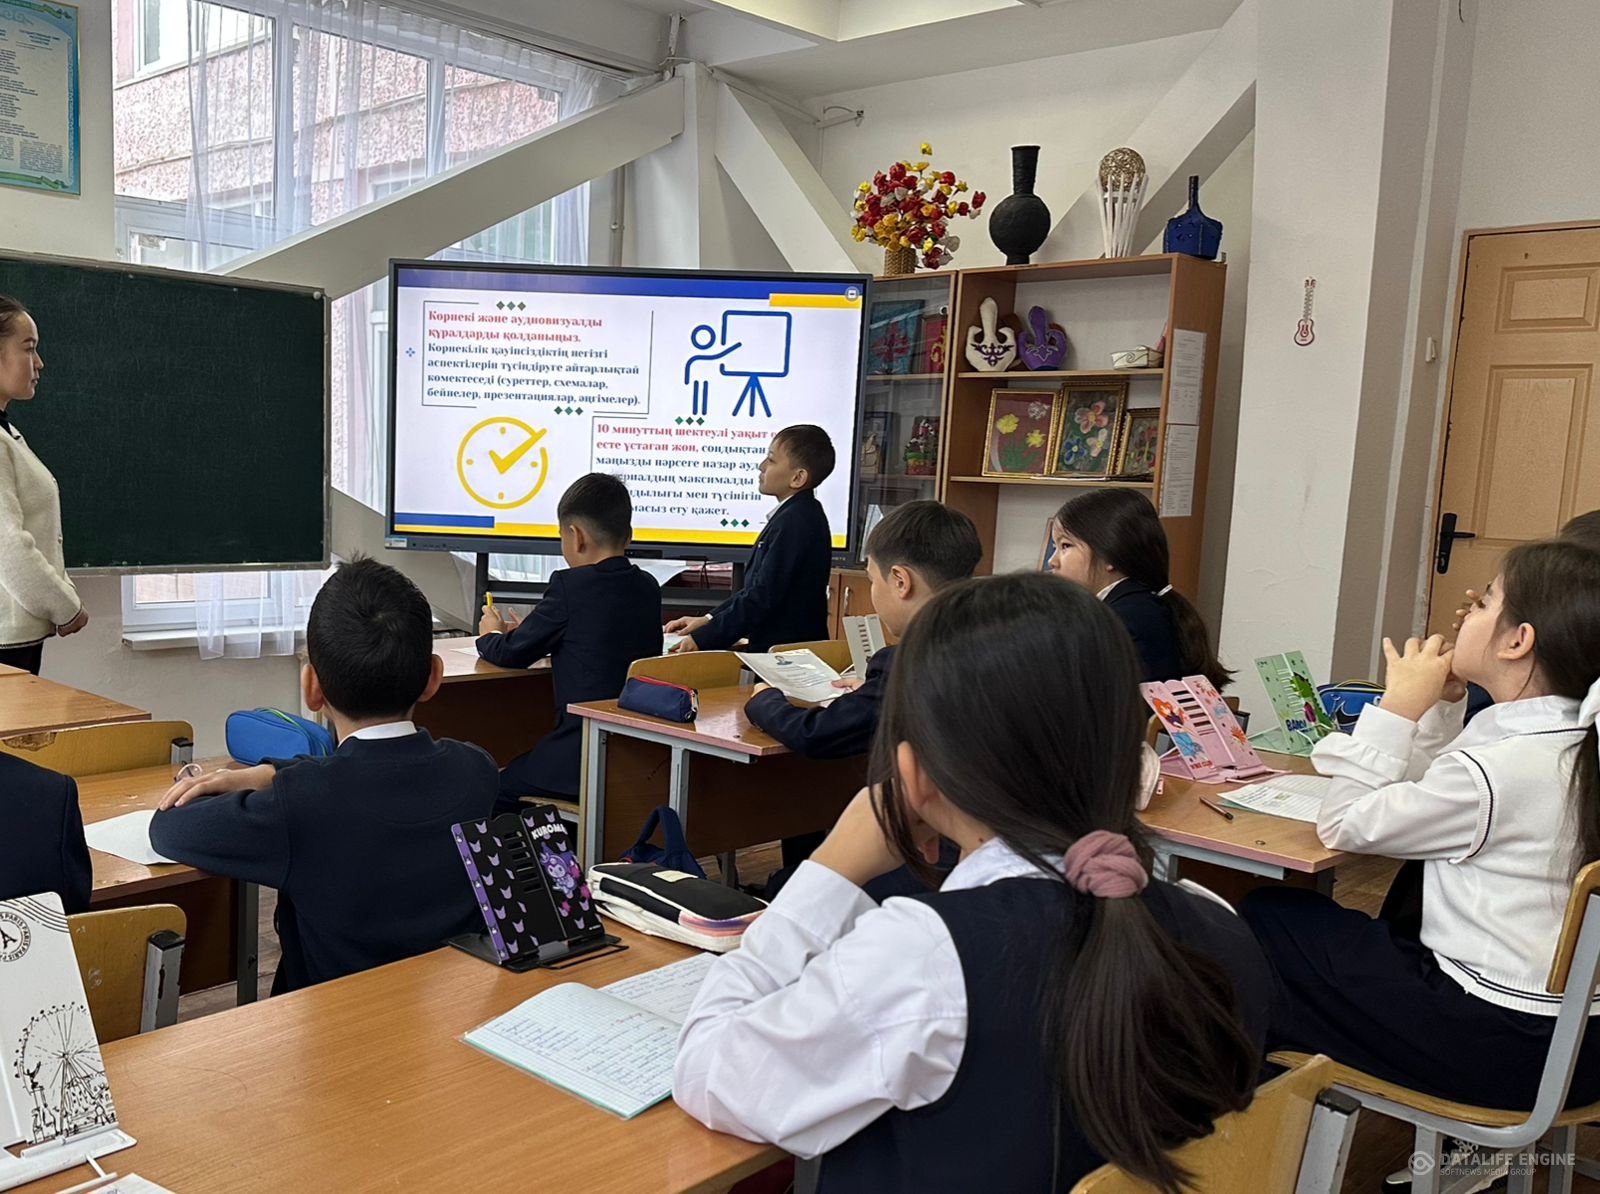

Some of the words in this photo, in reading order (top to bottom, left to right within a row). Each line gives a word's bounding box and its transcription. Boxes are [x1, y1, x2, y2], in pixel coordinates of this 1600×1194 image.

[597, 423, 610, 434] 10
[596, 441, 622, 450] есте
[703, 460, 736, 471] назар
[686, 490, 708, 499] мен
[531, 823, 569, 840] KUROMI
